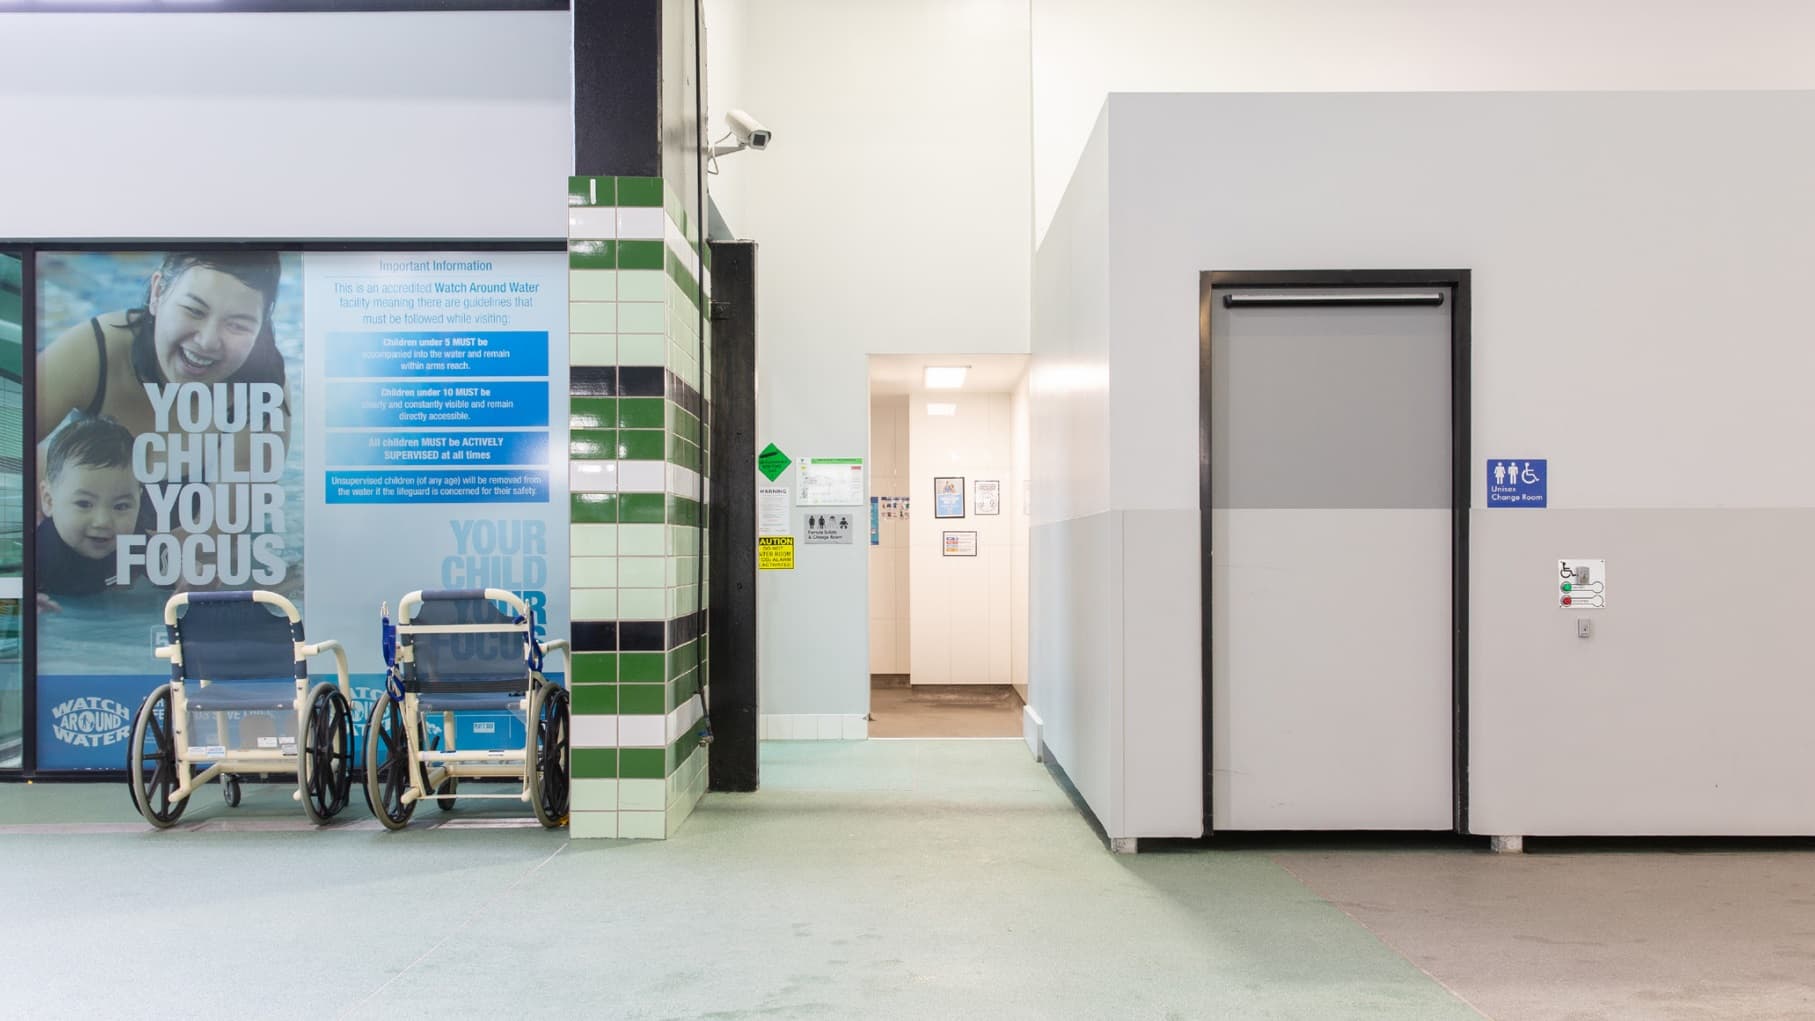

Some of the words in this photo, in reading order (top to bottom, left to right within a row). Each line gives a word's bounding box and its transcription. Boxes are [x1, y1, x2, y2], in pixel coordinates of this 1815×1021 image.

[380, 260, 429, 273] Important
[433, 260, 492, 271] Information
[334, 282, 353, 293] This
[356, 282, 364, 293] is
[366, 282, 379, 293] an
[381, 282, 432, 293] accredited
[434, 282, 467, 293] Watch
[470, 282, 506, 293] Around
[509, 282, 539, 293] Water
[339, 297, 370, 309] facility
[373, 297, 414, 309] meaning
[418, 297, 443, 307] there
[445, 297, 461, 307] are
[464, 297, 512, 309] guidelines
[514, 297, 533, 307] that
[362, 314, 387, 324] must
[389, 314, 402, 324] be
[404, 314, 444, 324] followed
[446, 314, 472, 324] while
[383, 337, 418, 346] Children
[419, 337, 443, 346] under
[445, 337, 450, 346] 5
[452, 337, 475, 346] MUST
[478, 337, 488, 346] be
[413, 349, 428, 358] into
[430, 349, 442, 358] the
[444, 349, 466, 358] water
[468, 349, 482, 358] and
[484, 349, 510, 358] remain
[426, 361, 445, 370] arms
[381, 388, 416, 396] Children
[417, 388, 441, 396] under
[443, 388, 453, 396] 10
[455, 388, 479, 396] MUST
[480, 388, 491, 396] be
[143, 382, 286, 432] YOUR
[388, 400, 403, 408] and
[404, 400, 443, 410] constantly
[445, 400, 469, 408] visible
[471, 400, 485, 408] and
[487, 400, 514, 408] remain
[399, 412, 427, 422] directly
[382, 438, 419, 447] children
[421, 438, 446, 447] MUST
[448, 438, 460, 447] be
[462, 438, 504, 447] ACTIVELY
[132, 432, 286, 483] CHILD
[384, 450, 439, 460] SUPERVISED
[441, 450, 451, 460] at
[452, 450, 464, 460] all
[466, 450, 491, 460] times
[331, 476, 382, 486] Unsupervised
[384, 476, 415, 484] children
[416, 476, 427, 486] (of
[428, 476, 442, 487] any
[443, 476, 461, 487] age)
[463, 476, 475, 484] will
[476, 476, 487, 484] be
[488, 476, 523, 484] removed
[523, 476, 542, 484] from
[338, 487, 350, 495] the
[351, 487, 373, 495] water
[375, 487, 381, 495] if
[382, 487, 395, 495] the
[396, 487, 431, 497] lifeguard
[432, 487, 439, 495] is
[440, 487, 480, 495] concerned
[482, 487, 492, 495] for
[494, 487, 511, 495] their
[144, 483, 287, 533] YOUR
[449, 519, 546, 555] YOUR
[115, 534, 287, 586] FOCUS
[441, 555, 547, 590] CHILD
[52, 697, 130, 720] WATCH
[60, 710, 122, 733] AROUND
[52, 724, 130, 747] WATER
